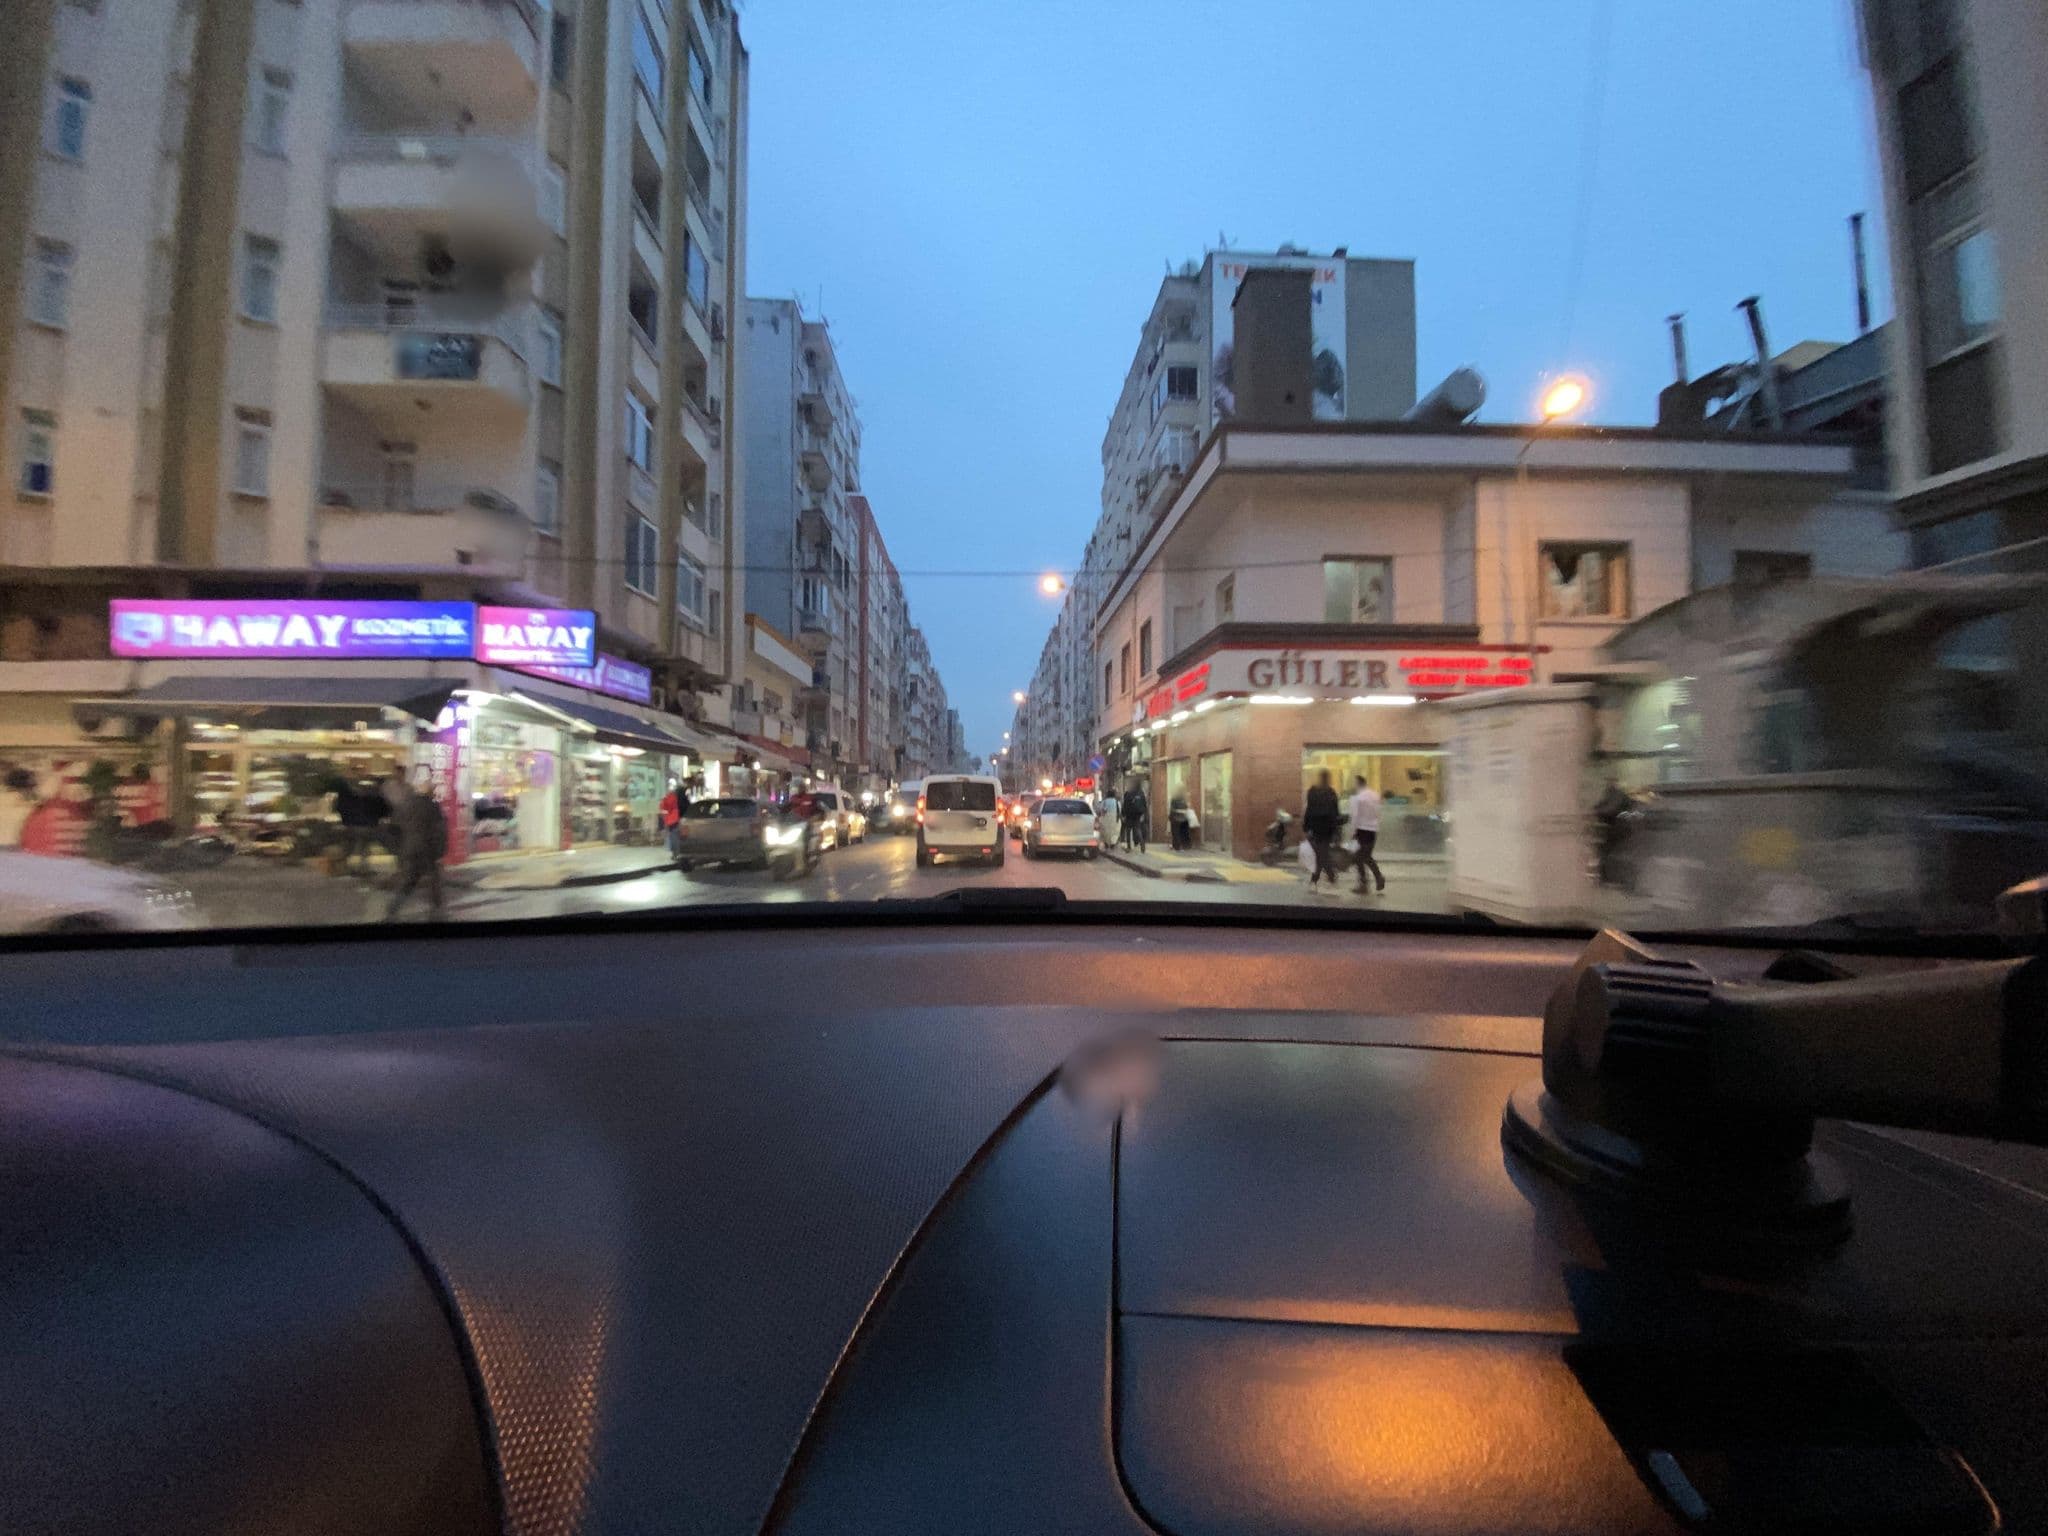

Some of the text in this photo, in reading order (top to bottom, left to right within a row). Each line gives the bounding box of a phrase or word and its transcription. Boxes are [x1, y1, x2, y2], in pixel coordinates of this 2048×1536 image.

[170, 614, 348, 648] HAWAY
[482, 623, 593, 649] HAWAY
[1248, 649, 1389, 688] GÜLER
